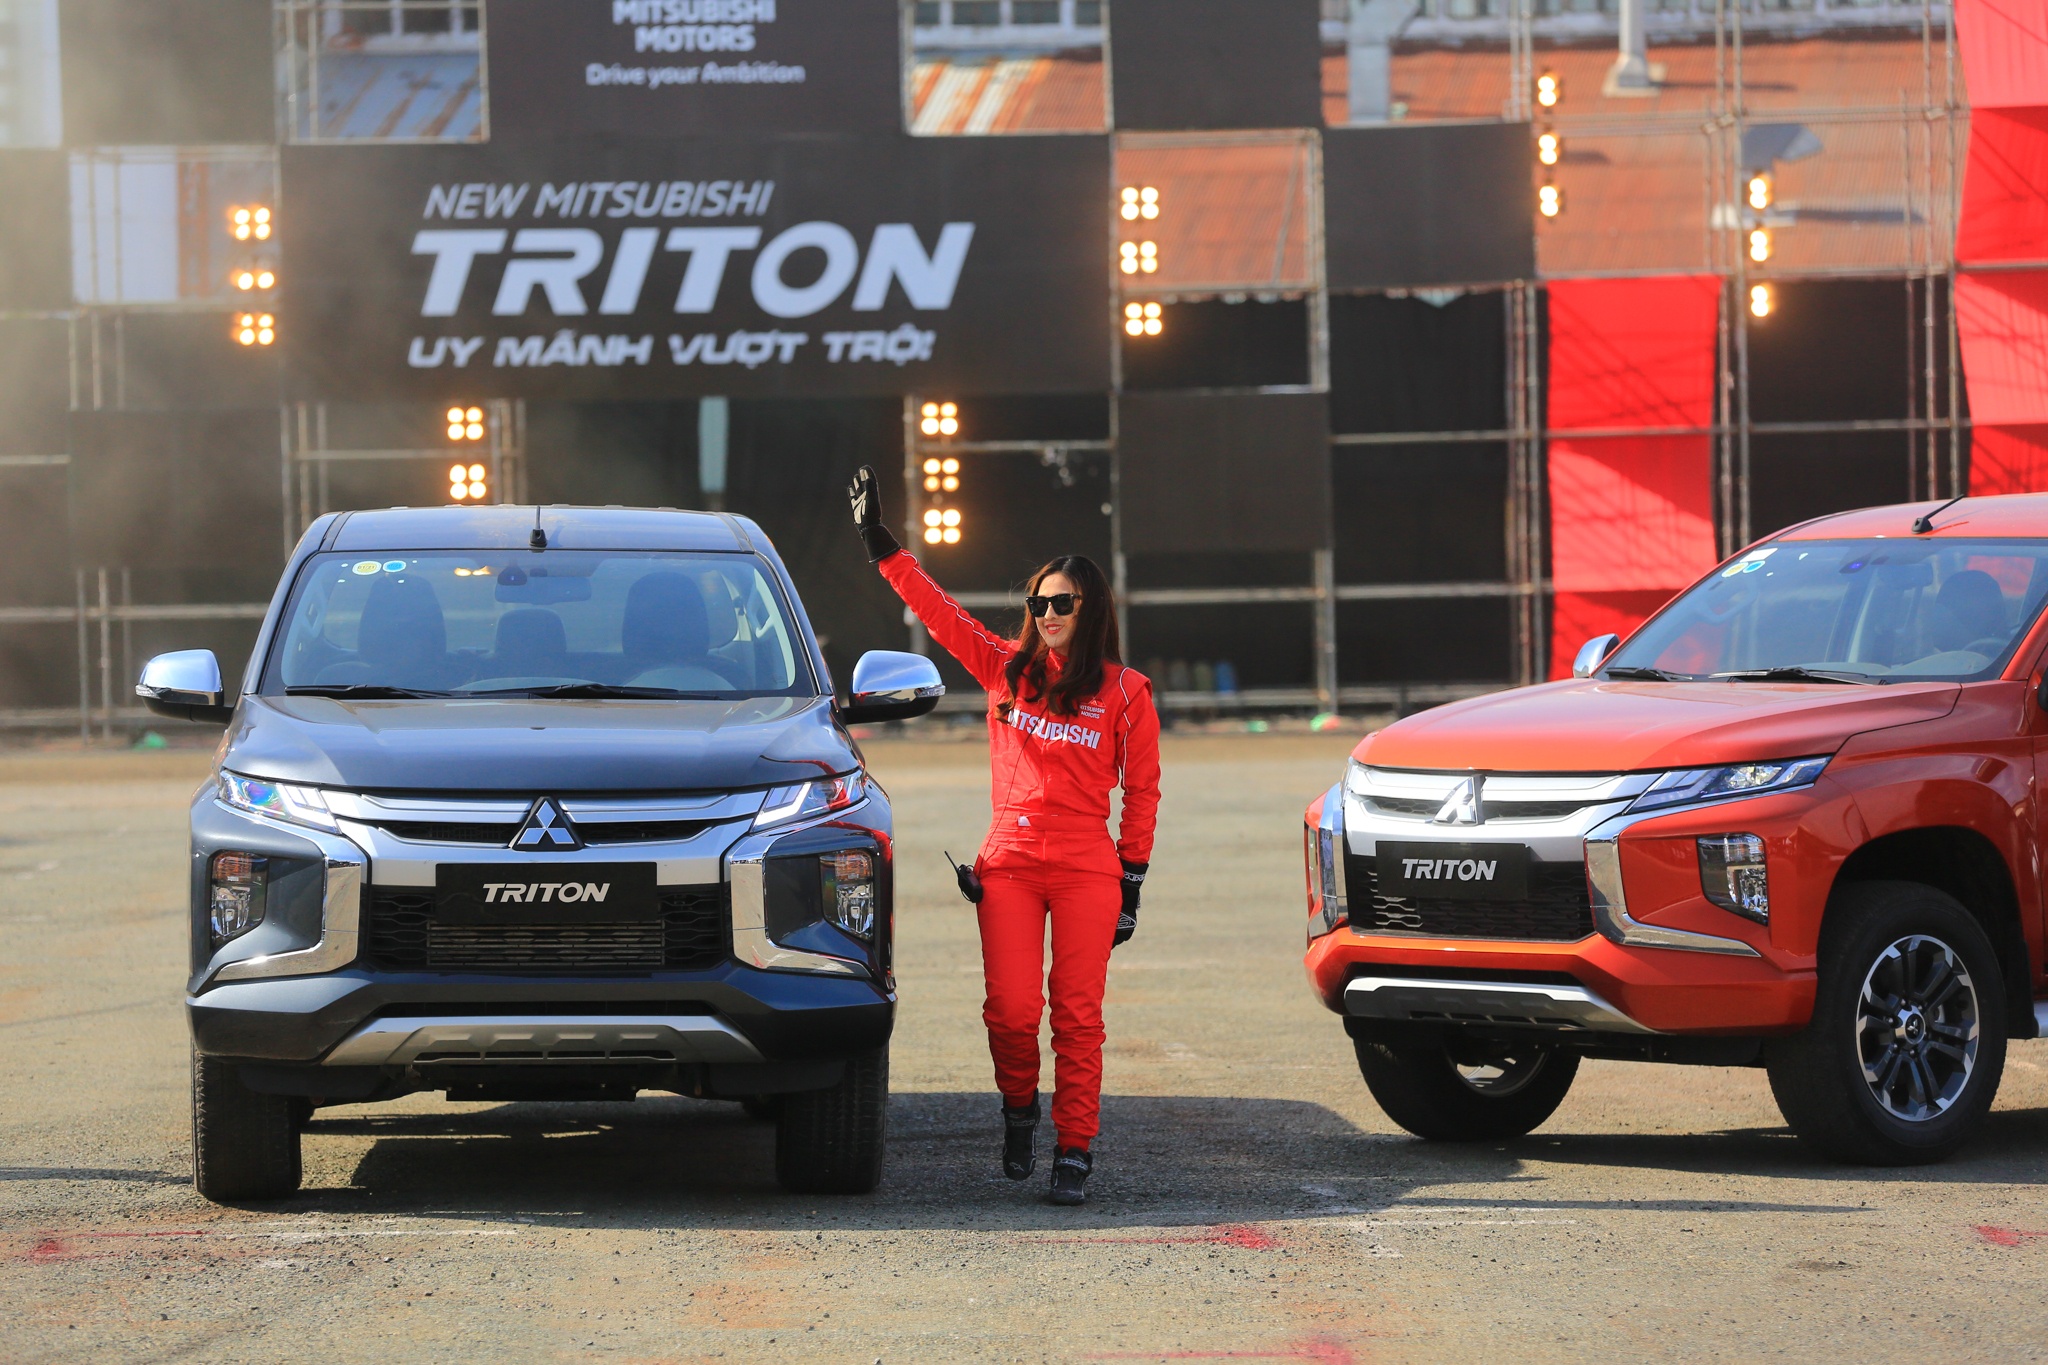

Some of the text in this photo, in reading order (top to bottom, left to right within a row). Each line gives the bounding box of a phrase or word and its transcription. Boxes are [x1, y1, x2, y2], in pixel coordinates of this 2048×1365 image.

[612, 0, 776, 24] MITSUBISHI
[634, 25, 757, 52] MOTORS
[586, 61, 806, 89] Drive your Ambition
[423, 180, 775, 219] NEW MITSUBISHI
[411, 221, 975, 318] TRITON
[407, 336, 484, 368] UY
[668, 329, 809, 369] VƯỢT
[1080, 711, 1100, 719] MOTORS
[1007, 709, 1101, 749] MITSUBISHI
[1401, 858, 1497, 881] TRITON
[483, 882, 610, 903] TRITON
